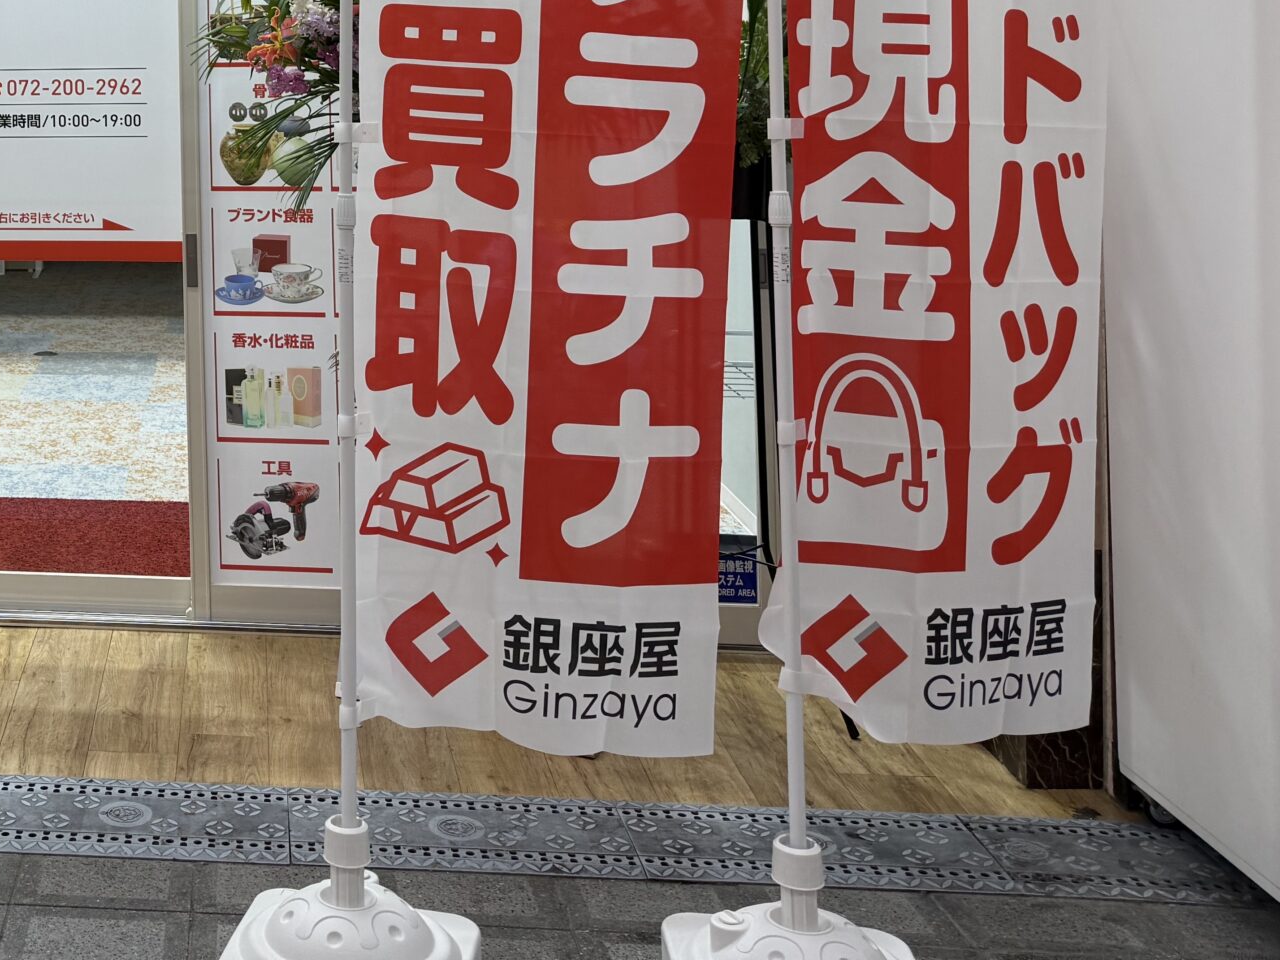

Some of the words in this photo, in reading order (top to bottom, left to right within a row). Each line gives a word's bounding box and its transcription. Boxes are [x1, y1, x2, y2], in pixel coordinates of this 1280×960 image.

[7, 78, 142, 97] 072-200-2962
[227, 207, 314, 224] ブランド食器
[231, 332, 315, 349] 香水・化粧品
[261, 460, 293, 477] 工具
[502, 614, 681, 679] 銀座屋
[924, 598, 1067, 666] 銀座屋
[502, 679, 678, 729] Ginzaya
[923, 668, 1063, 711] Ginzaya
